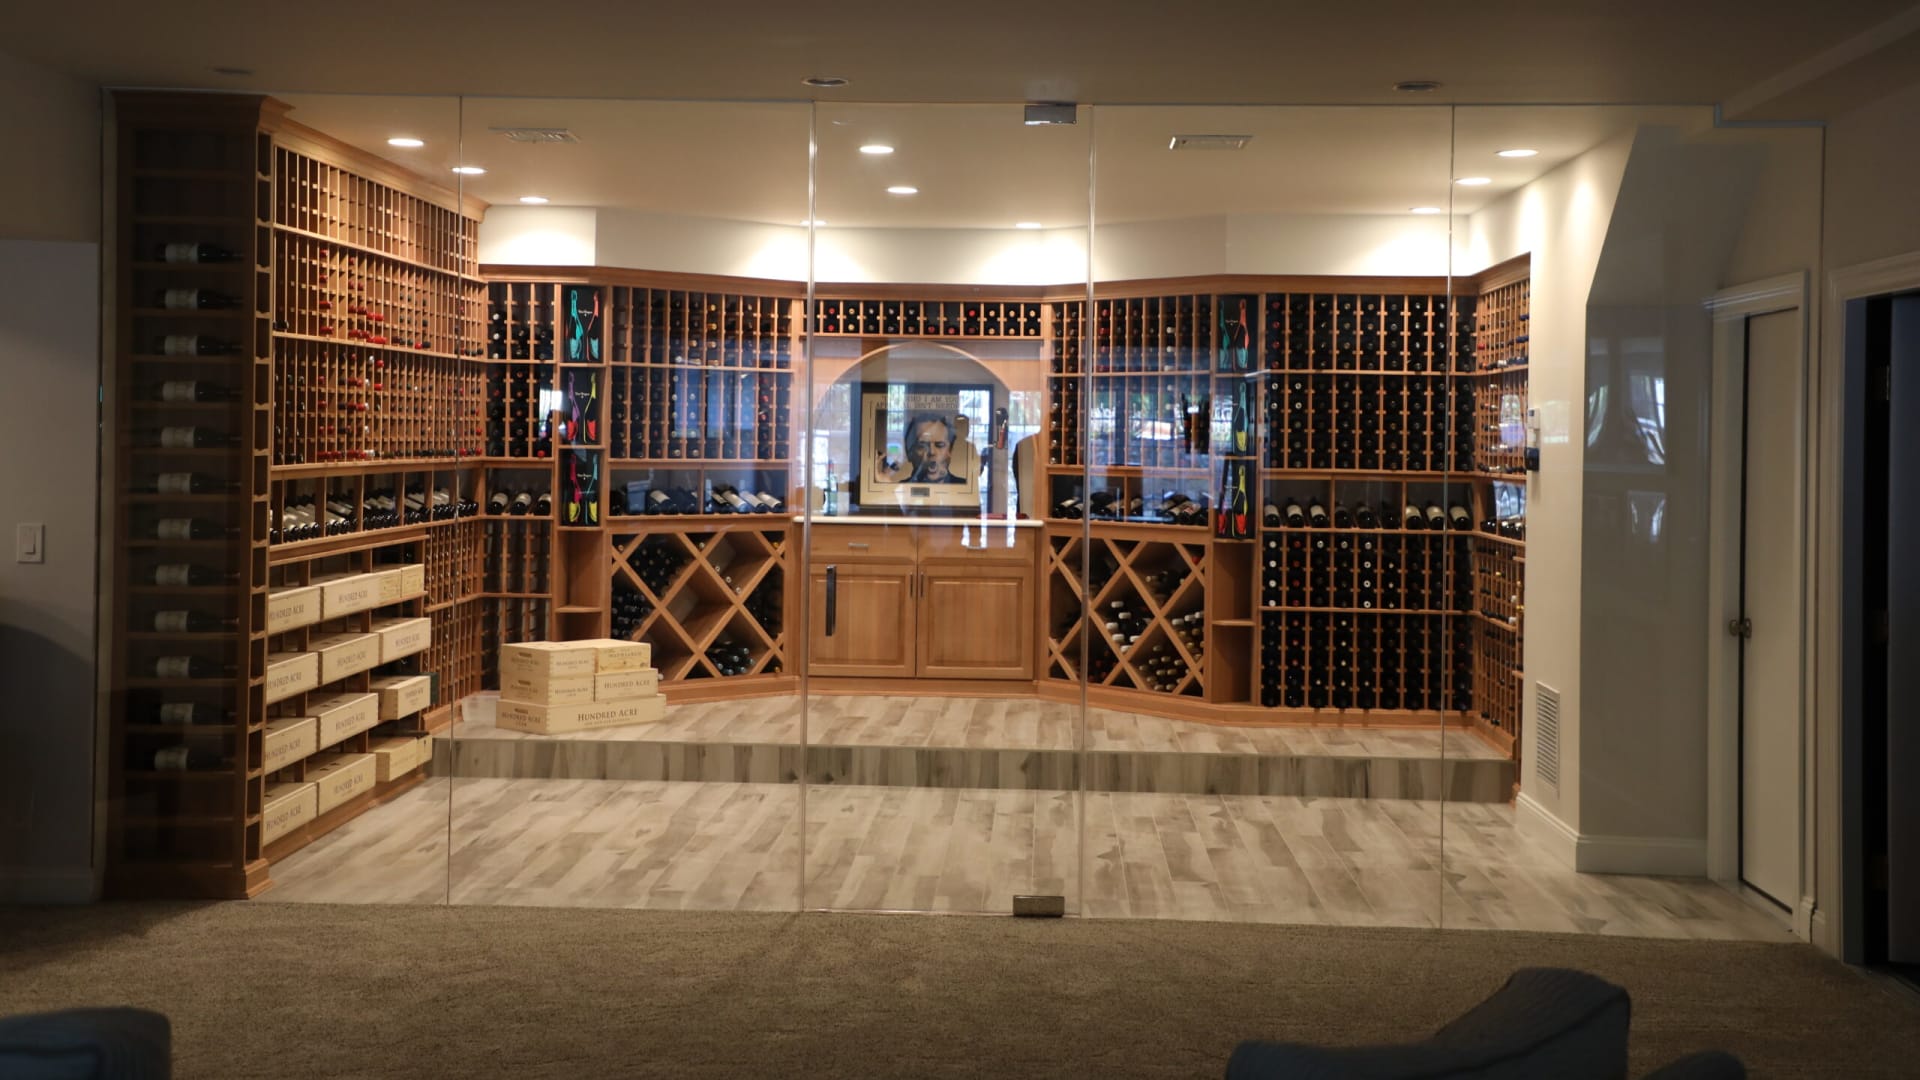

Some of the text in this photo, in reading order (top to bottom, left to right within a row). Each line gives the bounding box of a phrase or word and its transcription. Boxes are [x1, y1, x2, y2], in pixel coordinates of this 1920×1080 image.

[604, 679, 650, 689] HUNDRED ACRE
[577, 711, 617, 722] HUNDRED
[618, 708, 638, 717] ACRE
